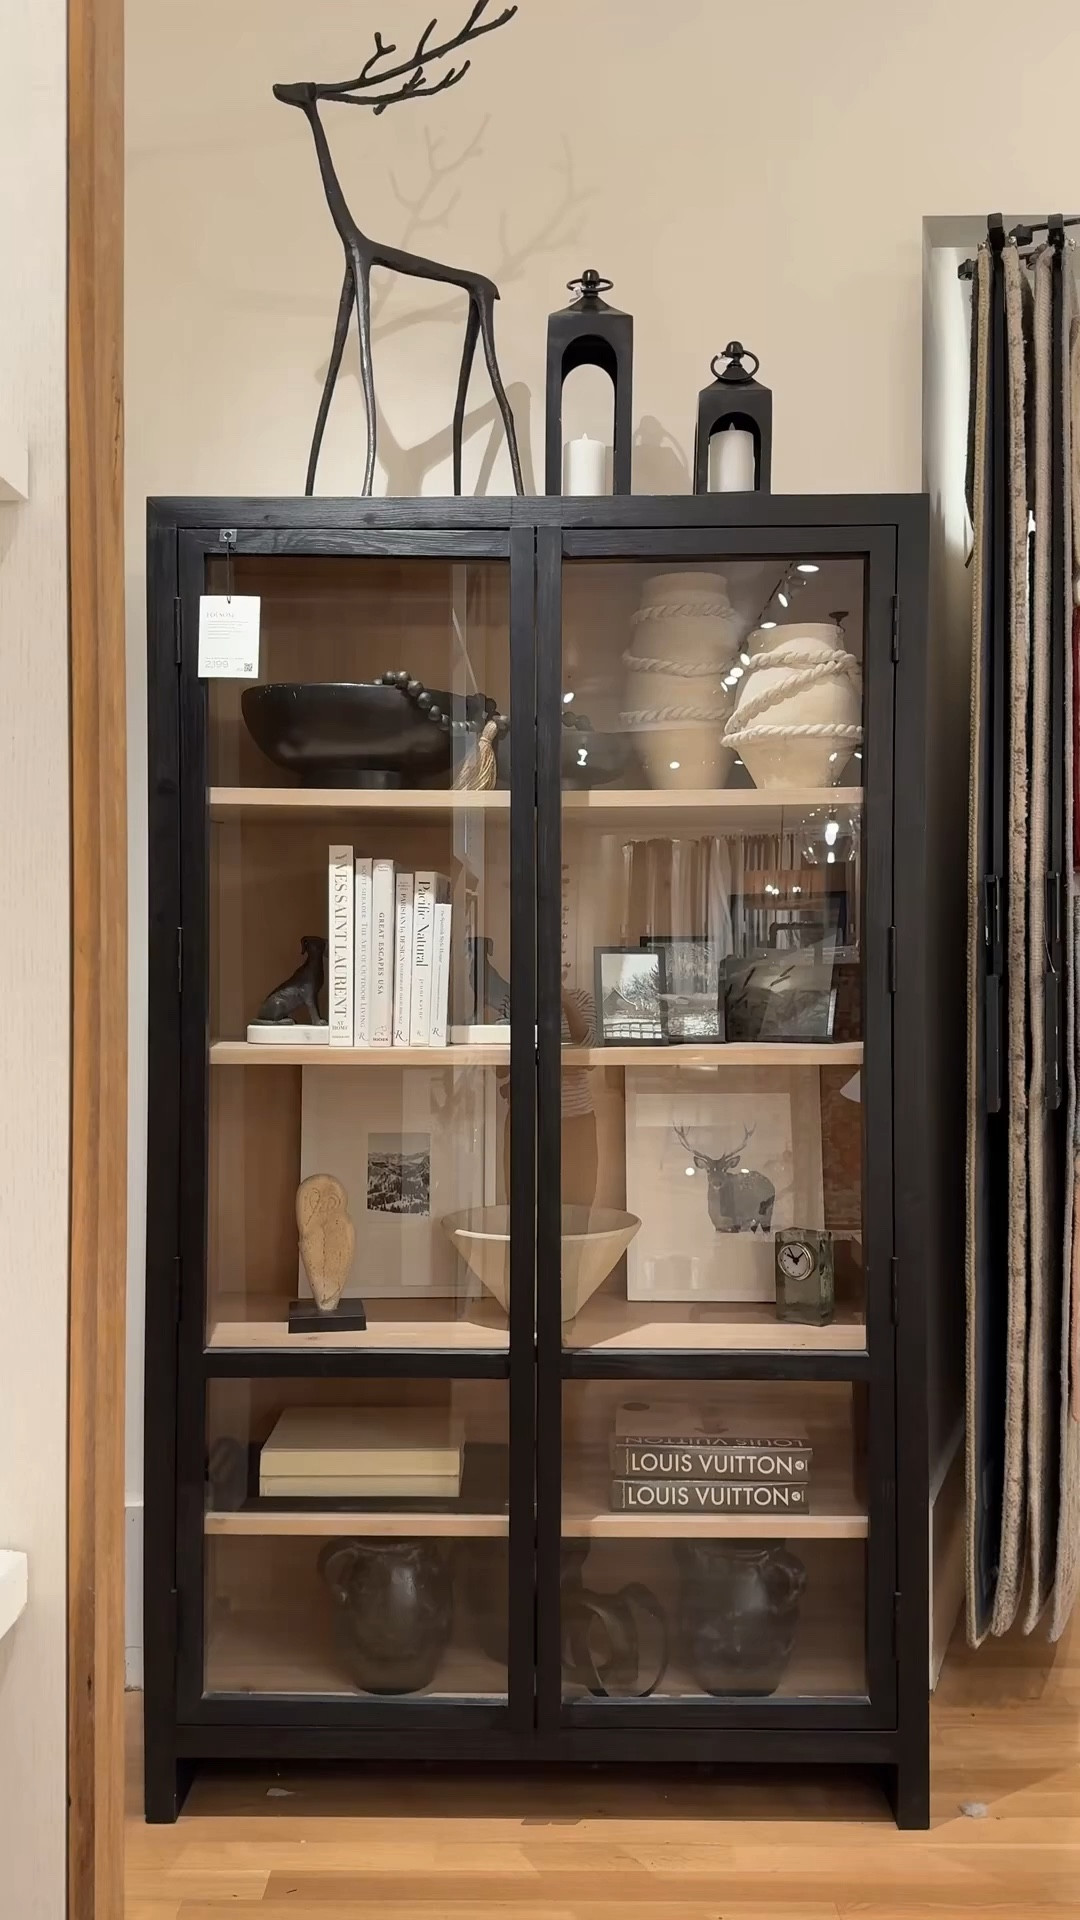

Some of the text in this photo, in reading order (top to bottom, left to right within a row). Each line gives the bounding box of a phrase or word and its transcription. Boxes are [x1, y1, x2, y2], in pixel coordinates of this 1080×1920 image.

[399, 893, 407, 925] PARISIAN
[416, 881, 431, 967] Pacific Natural
[334, 853, 348, 1018] YVES SAINT LAURENT
[377, 942, 385, 976] ESCAPES
[631, 1453, 793, 1475] LOUIS VUITTON
[628, 1486, 789, 1506] LOUIS VUITTON
